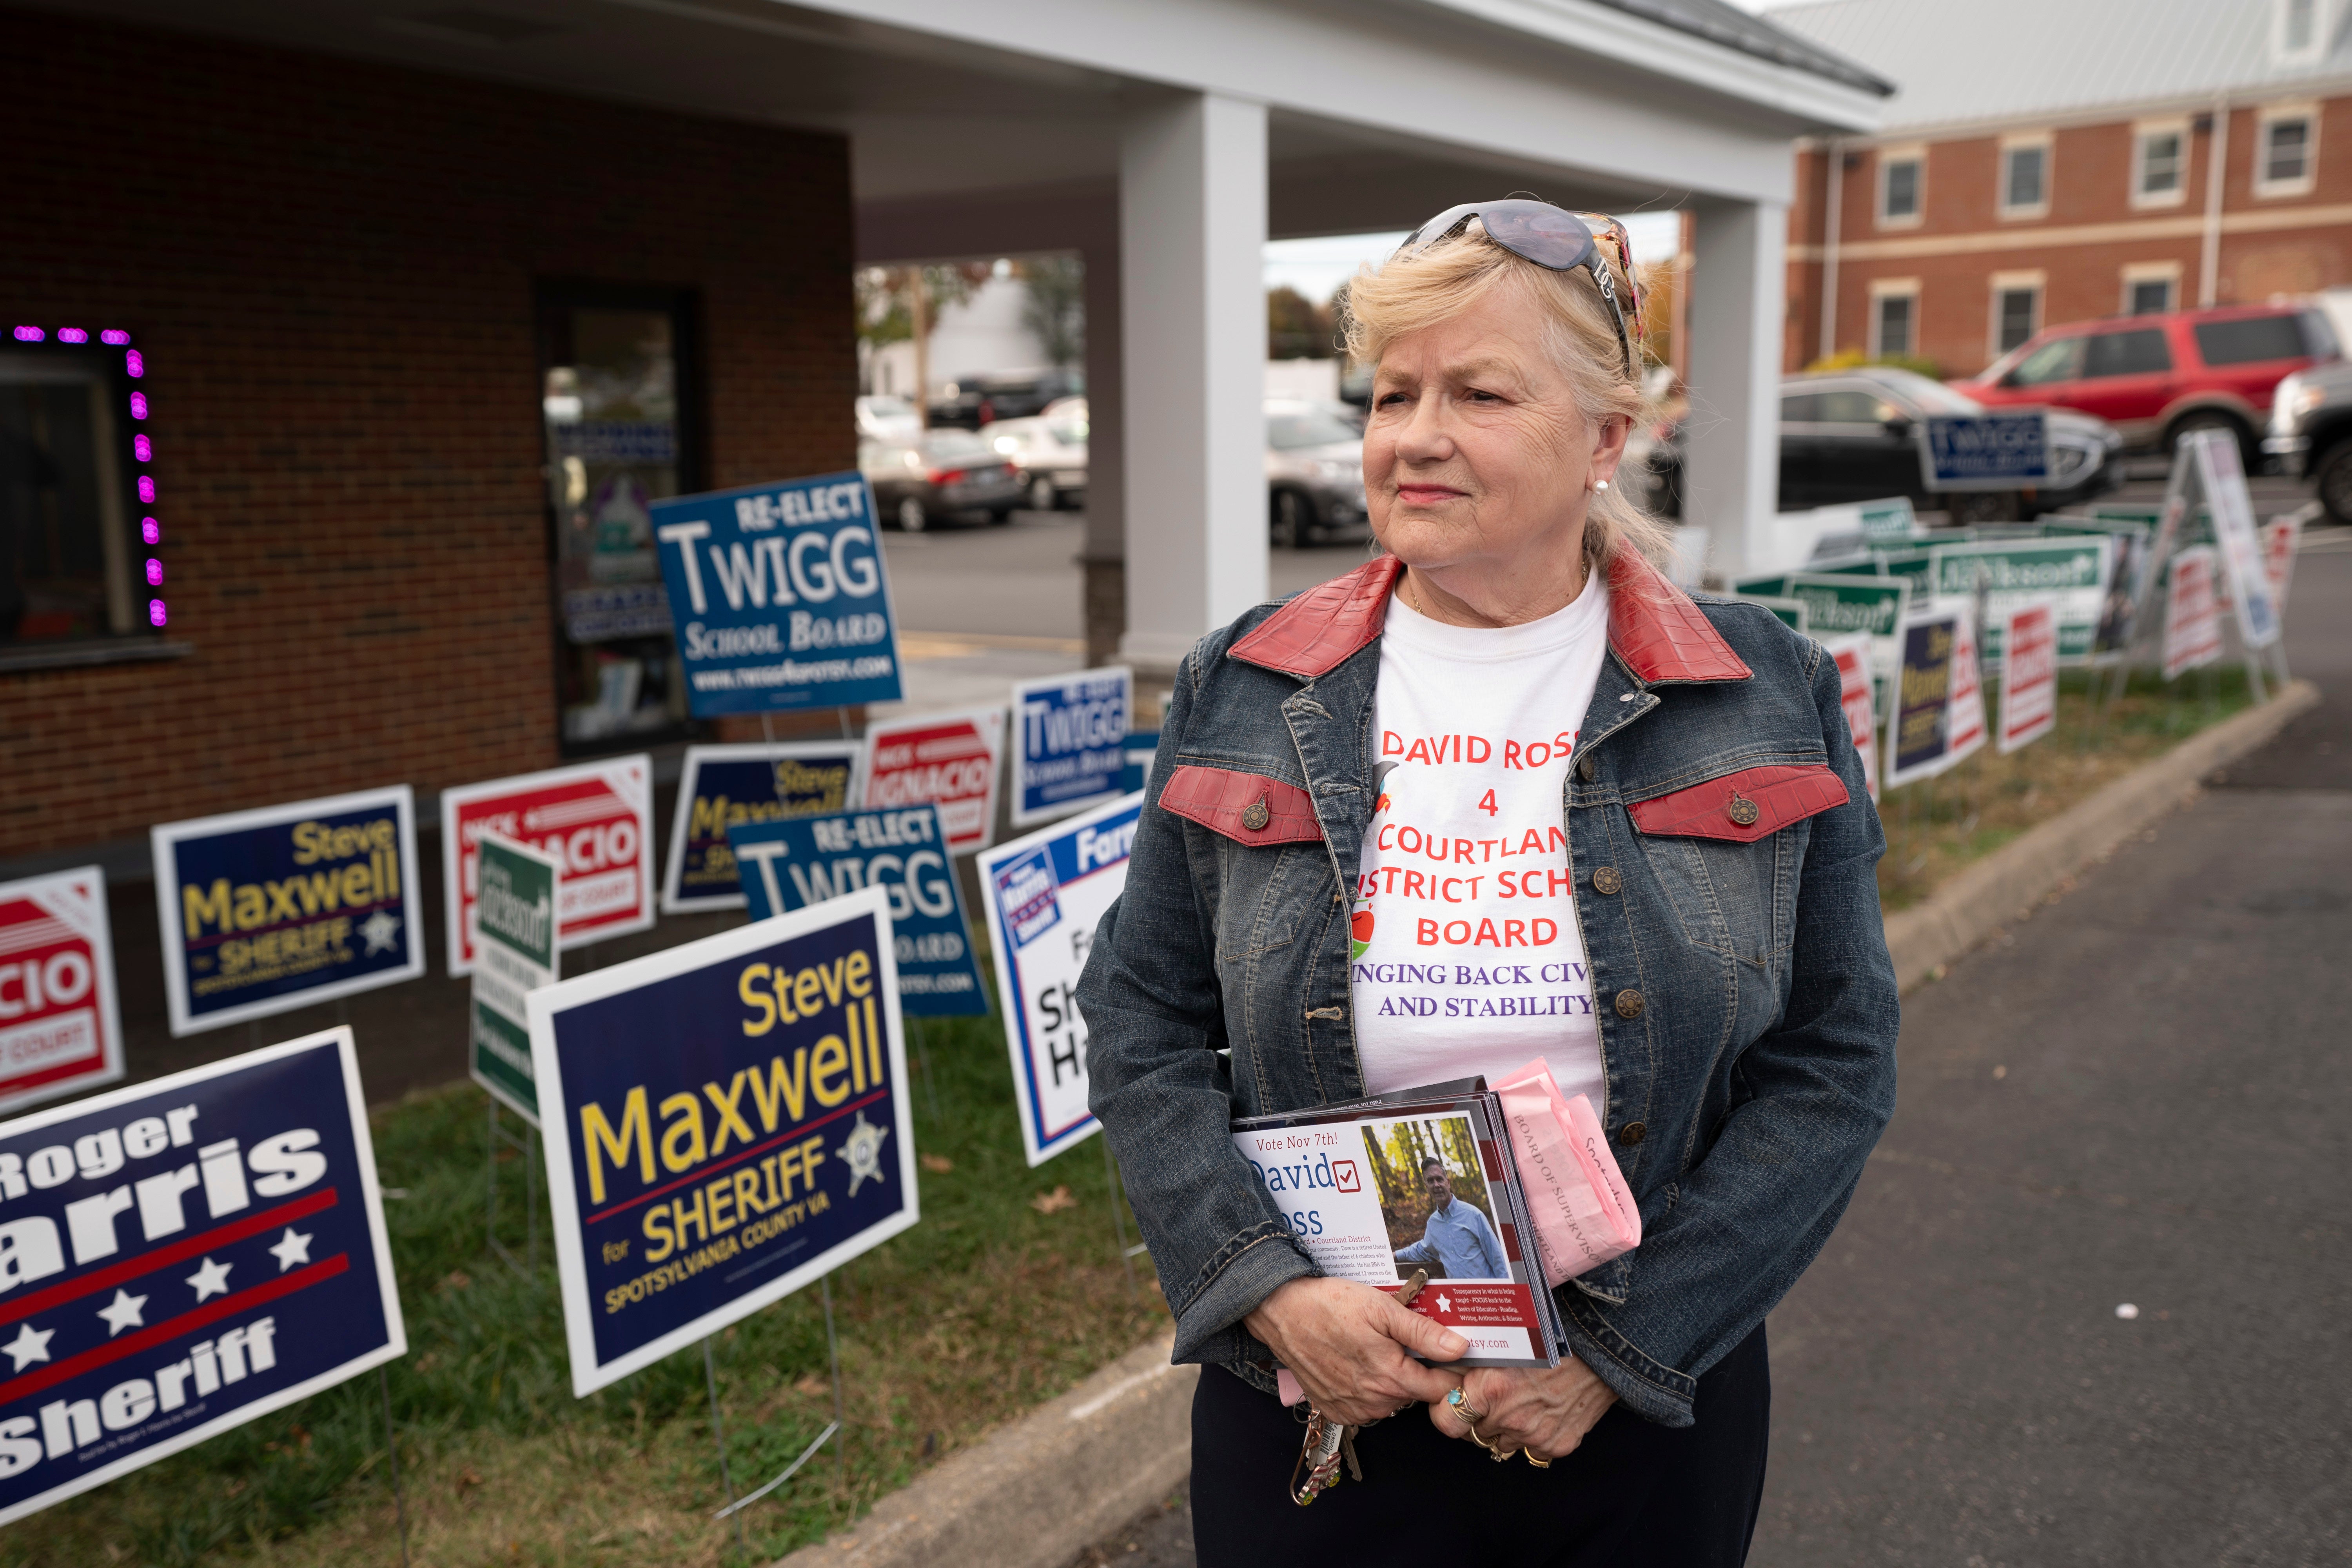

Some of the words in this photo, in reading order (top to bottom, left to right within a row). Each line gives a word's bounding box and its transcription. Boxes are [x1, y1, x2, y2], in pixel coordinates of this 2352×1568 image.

[735, 482, 863, 533] RE-ELECT
[658, 521, 880, 615] TWIGG
[685, 622, 784, 661] SCHOOL
[788, 610, 886, 652] BOARD
[1025, 697, 1124, 759] TWIGG
[1383, 731, 1491, 765] DAVID
[1504, 731, 1580, 770] ROS
[777, 759, 848, 795] Steve
[1479, 789, 1498, 817] 4
[291, 818, 396, 865] Steve
[811, 808, 935, 853] RE-ELECT
[182, 850, 400, 941] Maxwell
[218, 916, 352, 975] SHERIFF
[1417, 918, 1557, 947] BOARD
[739, 950, 873, 1037] Steve
[1455, 965, 1532, 985] BACK
[1378, 997, 1437, 1016] AND
[1445, 995, 1592, 1016] STABILITY
[10, 1023, 84, 1065] COURT
[580, 996, 883, 1205] Maxwell
[0, 1103, 198, 1202] Roger
[1256, 1139, 1283, 1151] Vote
[1287, 1136, 1310, 1149] Nov
[1314, 1132, 1338, 1145] 7th!
[1514, 1114, 1544, 1163] BOARD
[1541, 1166, 1557, 1185] OF
[602, 1239, 630, 1265] for
[643, 1135, 826, 1263] SHERIFF
[605, 1234, 741, 1314] SPOTSYLVANIA
[741, 1200, 806, 1249] COUNTY
[806, 1189, 831, 1217] VA
